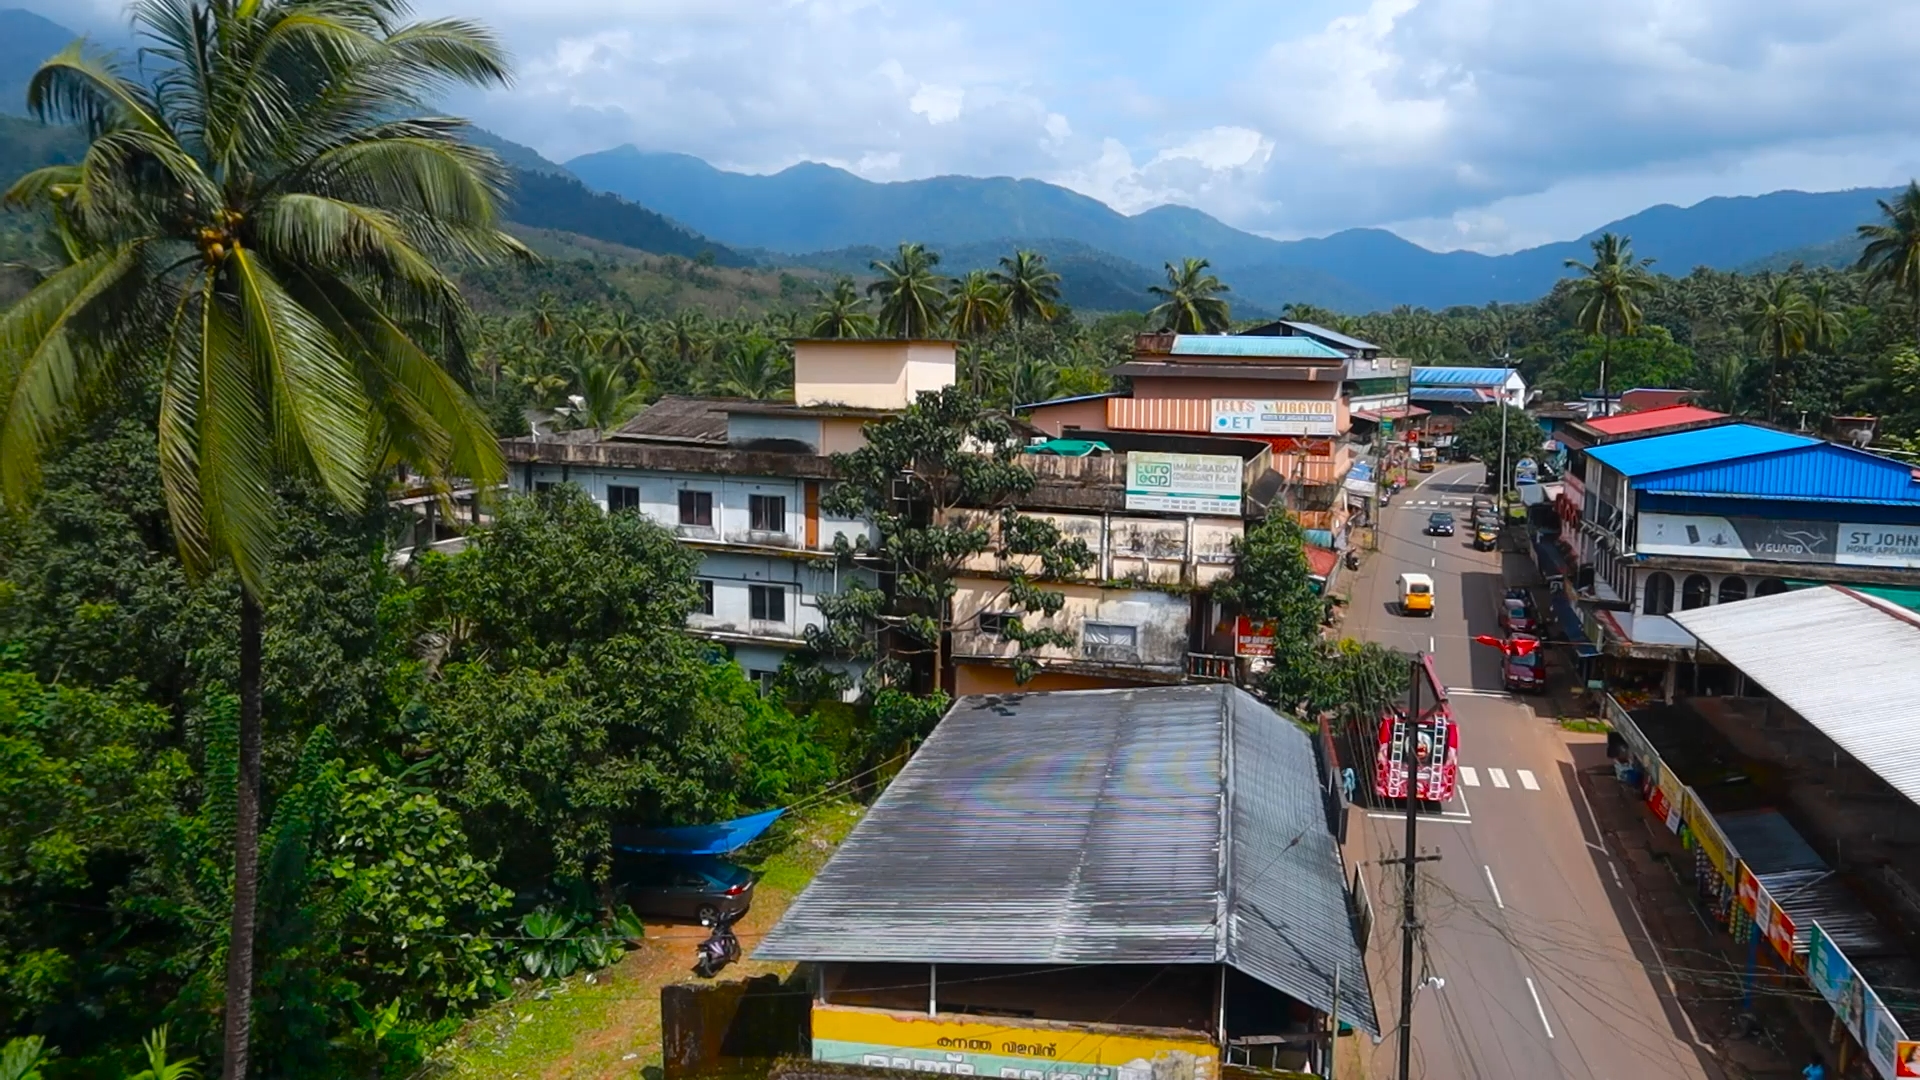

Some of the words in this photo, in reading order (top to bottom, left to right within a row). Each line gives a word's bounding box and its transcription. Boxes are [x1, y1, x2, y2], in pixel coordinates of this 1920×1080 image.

[1216, 400, 1255, 412] IELTS
[1173, 463, 1237, 474] IMMIGRATION
[1851, 532, 1872, 545] ST
[1846, 545, 1873, 553] HOME
